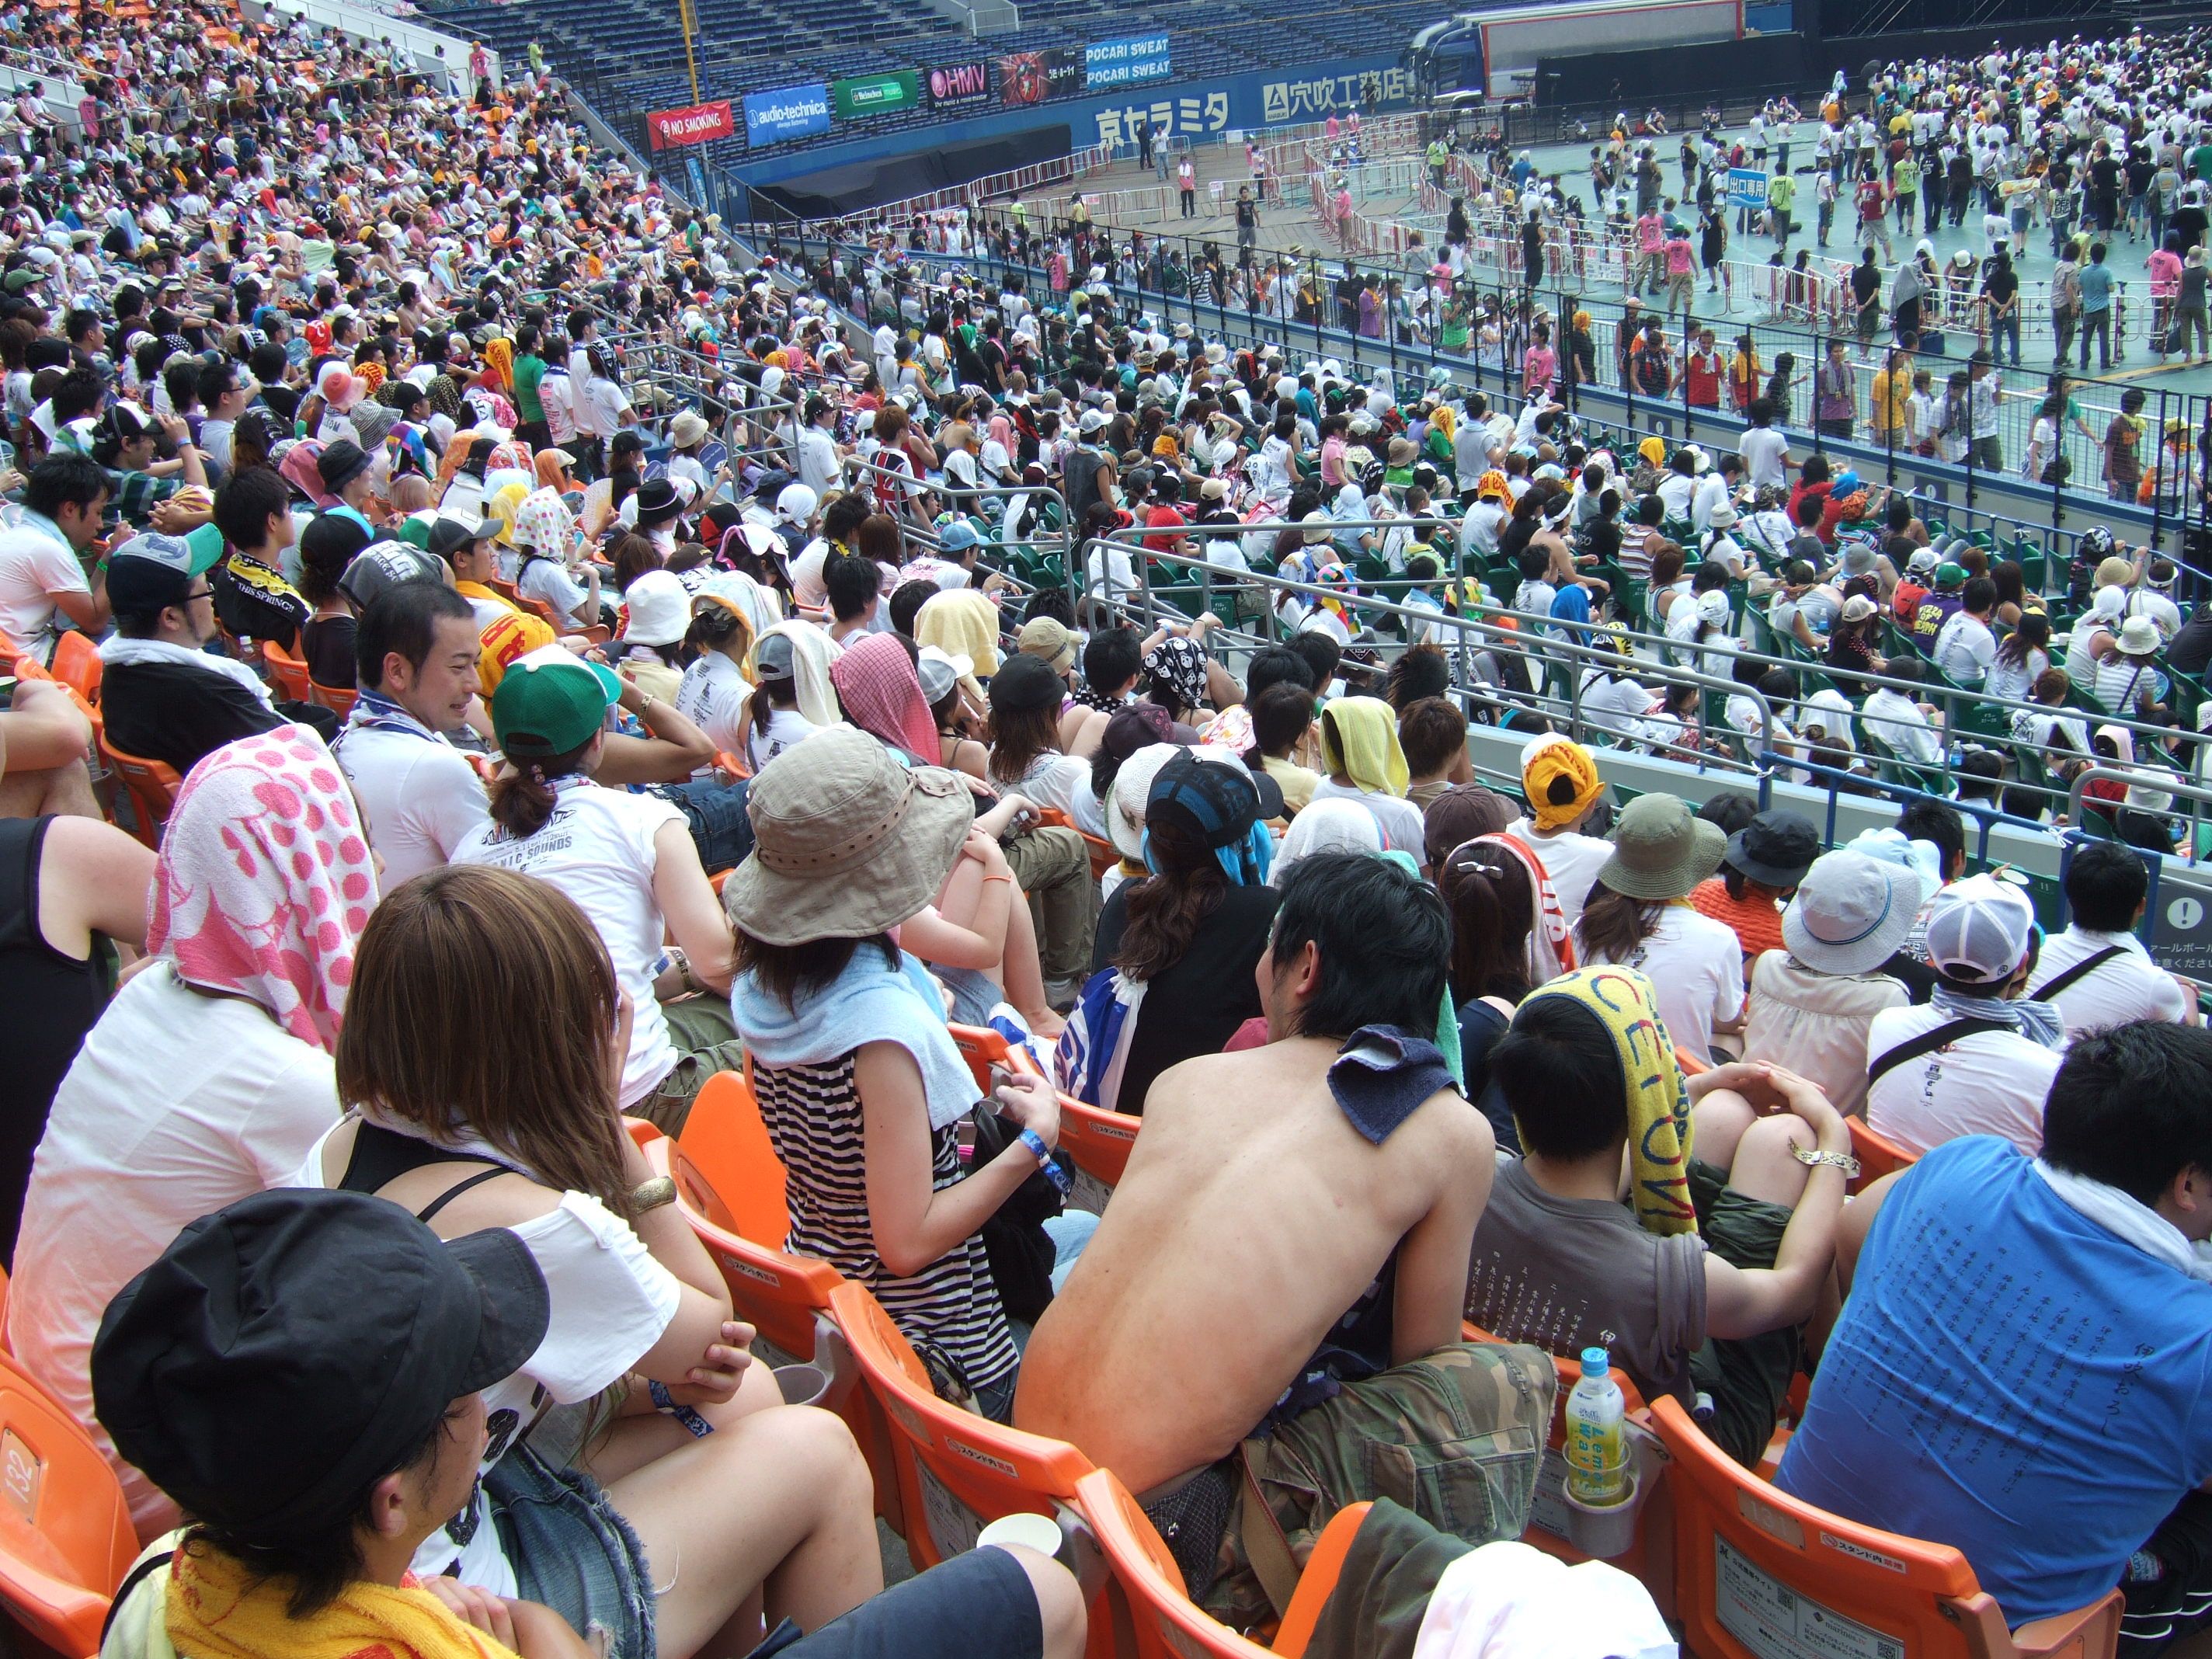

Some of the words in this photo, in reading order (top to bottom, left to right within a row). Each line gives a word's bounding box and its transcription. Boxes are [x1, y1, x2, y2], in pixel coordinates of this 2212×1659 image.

[1087, 44, 1128, 62] POCARI
[1131, 39, 1169, 56] SWEAT
[944, 63, 985, 96] HMV
[1087, 67, 1129, 85] POCARI
[1132, 60, 1170, 77] SWEAT
[759, 99, 826, 124] audio-technica
[1095, 91, 1229, 151] 京セラミタ
[671, 122, 684, 136] NO
[685, 113, 722, 134] SMOKING
[1730, 177, 1765, 198] 出口専用
[238, 582, 256, 596] THIS
[256, 587, 295, 614] SPRING!!
[527, 836, 572, 861] SOUNDS
[5, 1449, 33, 1504] 132
